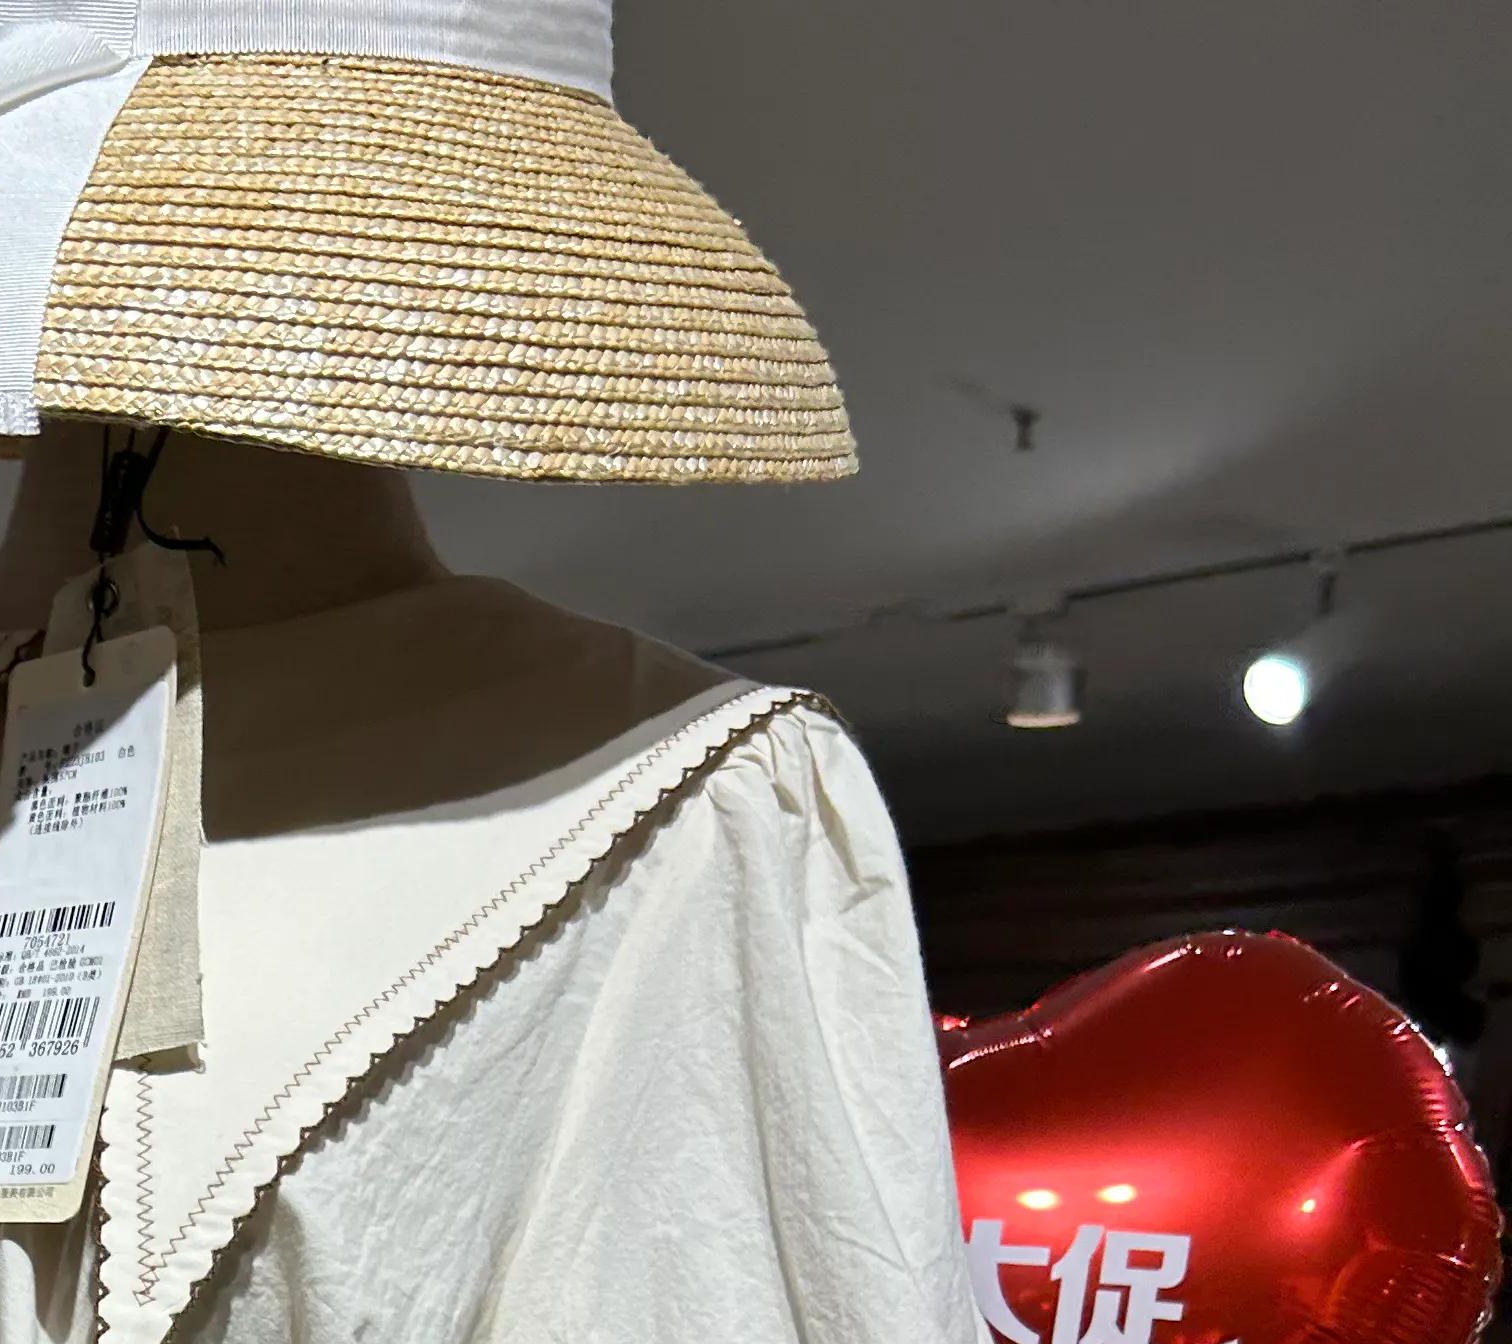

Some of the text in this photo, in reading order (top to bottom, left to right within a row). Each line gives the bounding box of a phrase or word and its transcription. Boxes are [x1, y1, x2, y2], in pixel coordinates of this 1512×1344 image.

[24, 933, 71, 949] 7054721
[29, 1040, 79, 1057] 367926
[10, 1163, 56, 1176] 199.00
